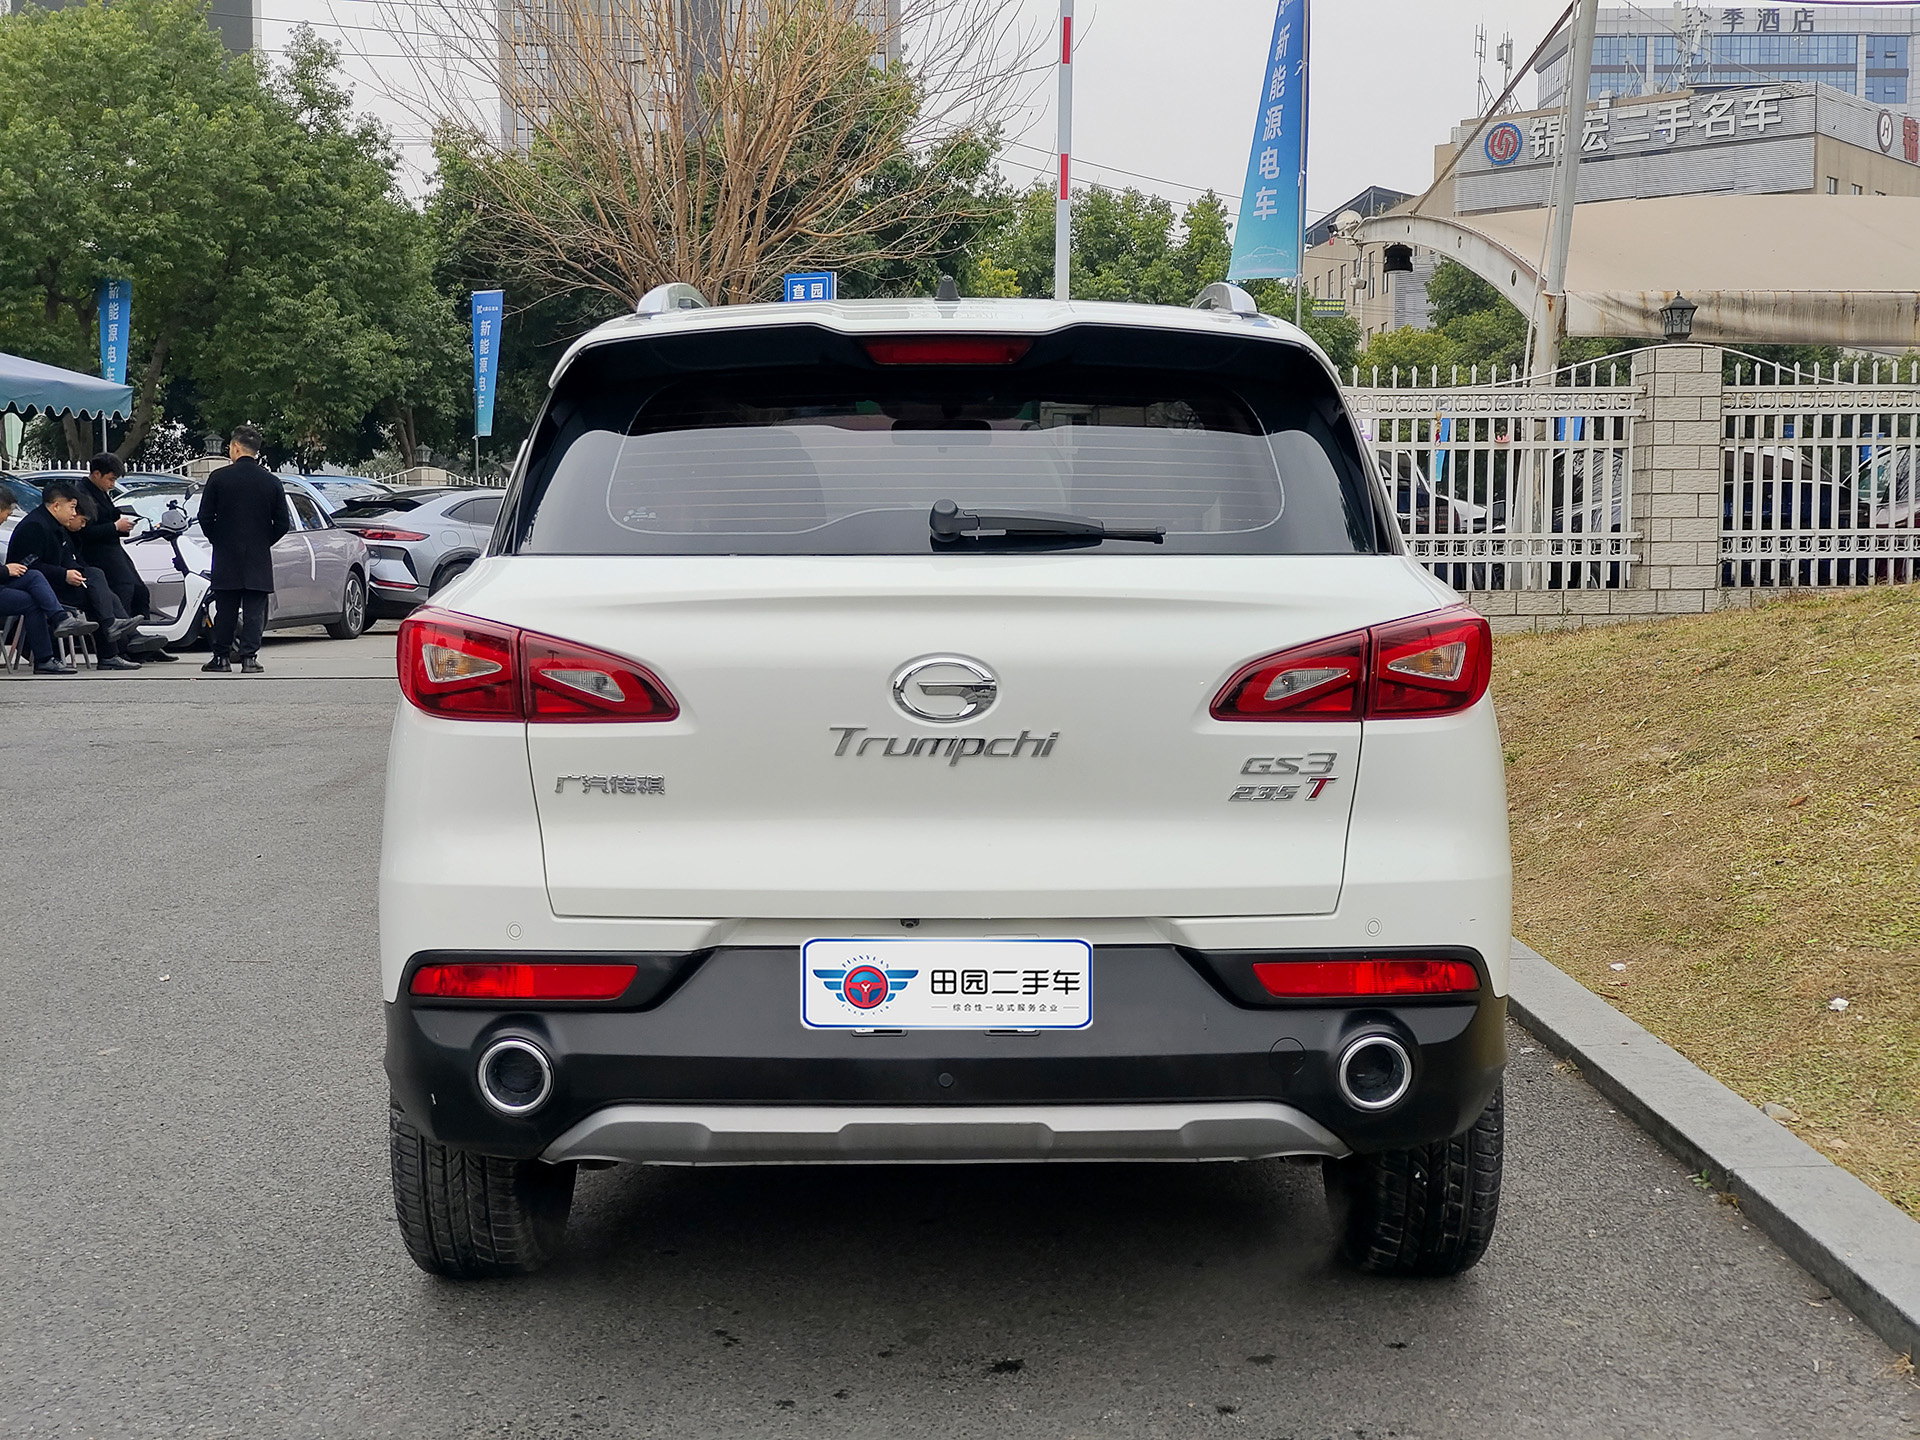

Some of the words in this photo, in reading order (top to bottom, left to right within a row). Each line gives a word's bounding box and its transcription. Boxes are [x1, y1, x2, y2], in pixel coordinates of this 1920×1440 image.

[1252, 22, 1292, 221] 新能源电车
[1529, 87, 1783, 160] 锦宏二手名车
[107, 281, 120, 382] 新能源电车
[478, 319, 492, 410] 新能源电车
[829, 724, 1060, 767] Trumpchi
[1240, 752, 1338, 775] GS3
[554, 774, 666, 795] 广汽传祺
[931, 969, 1081, 996] 田园二手车
[952, 1003, 1058, 1012] 综合性一站式服务企业
